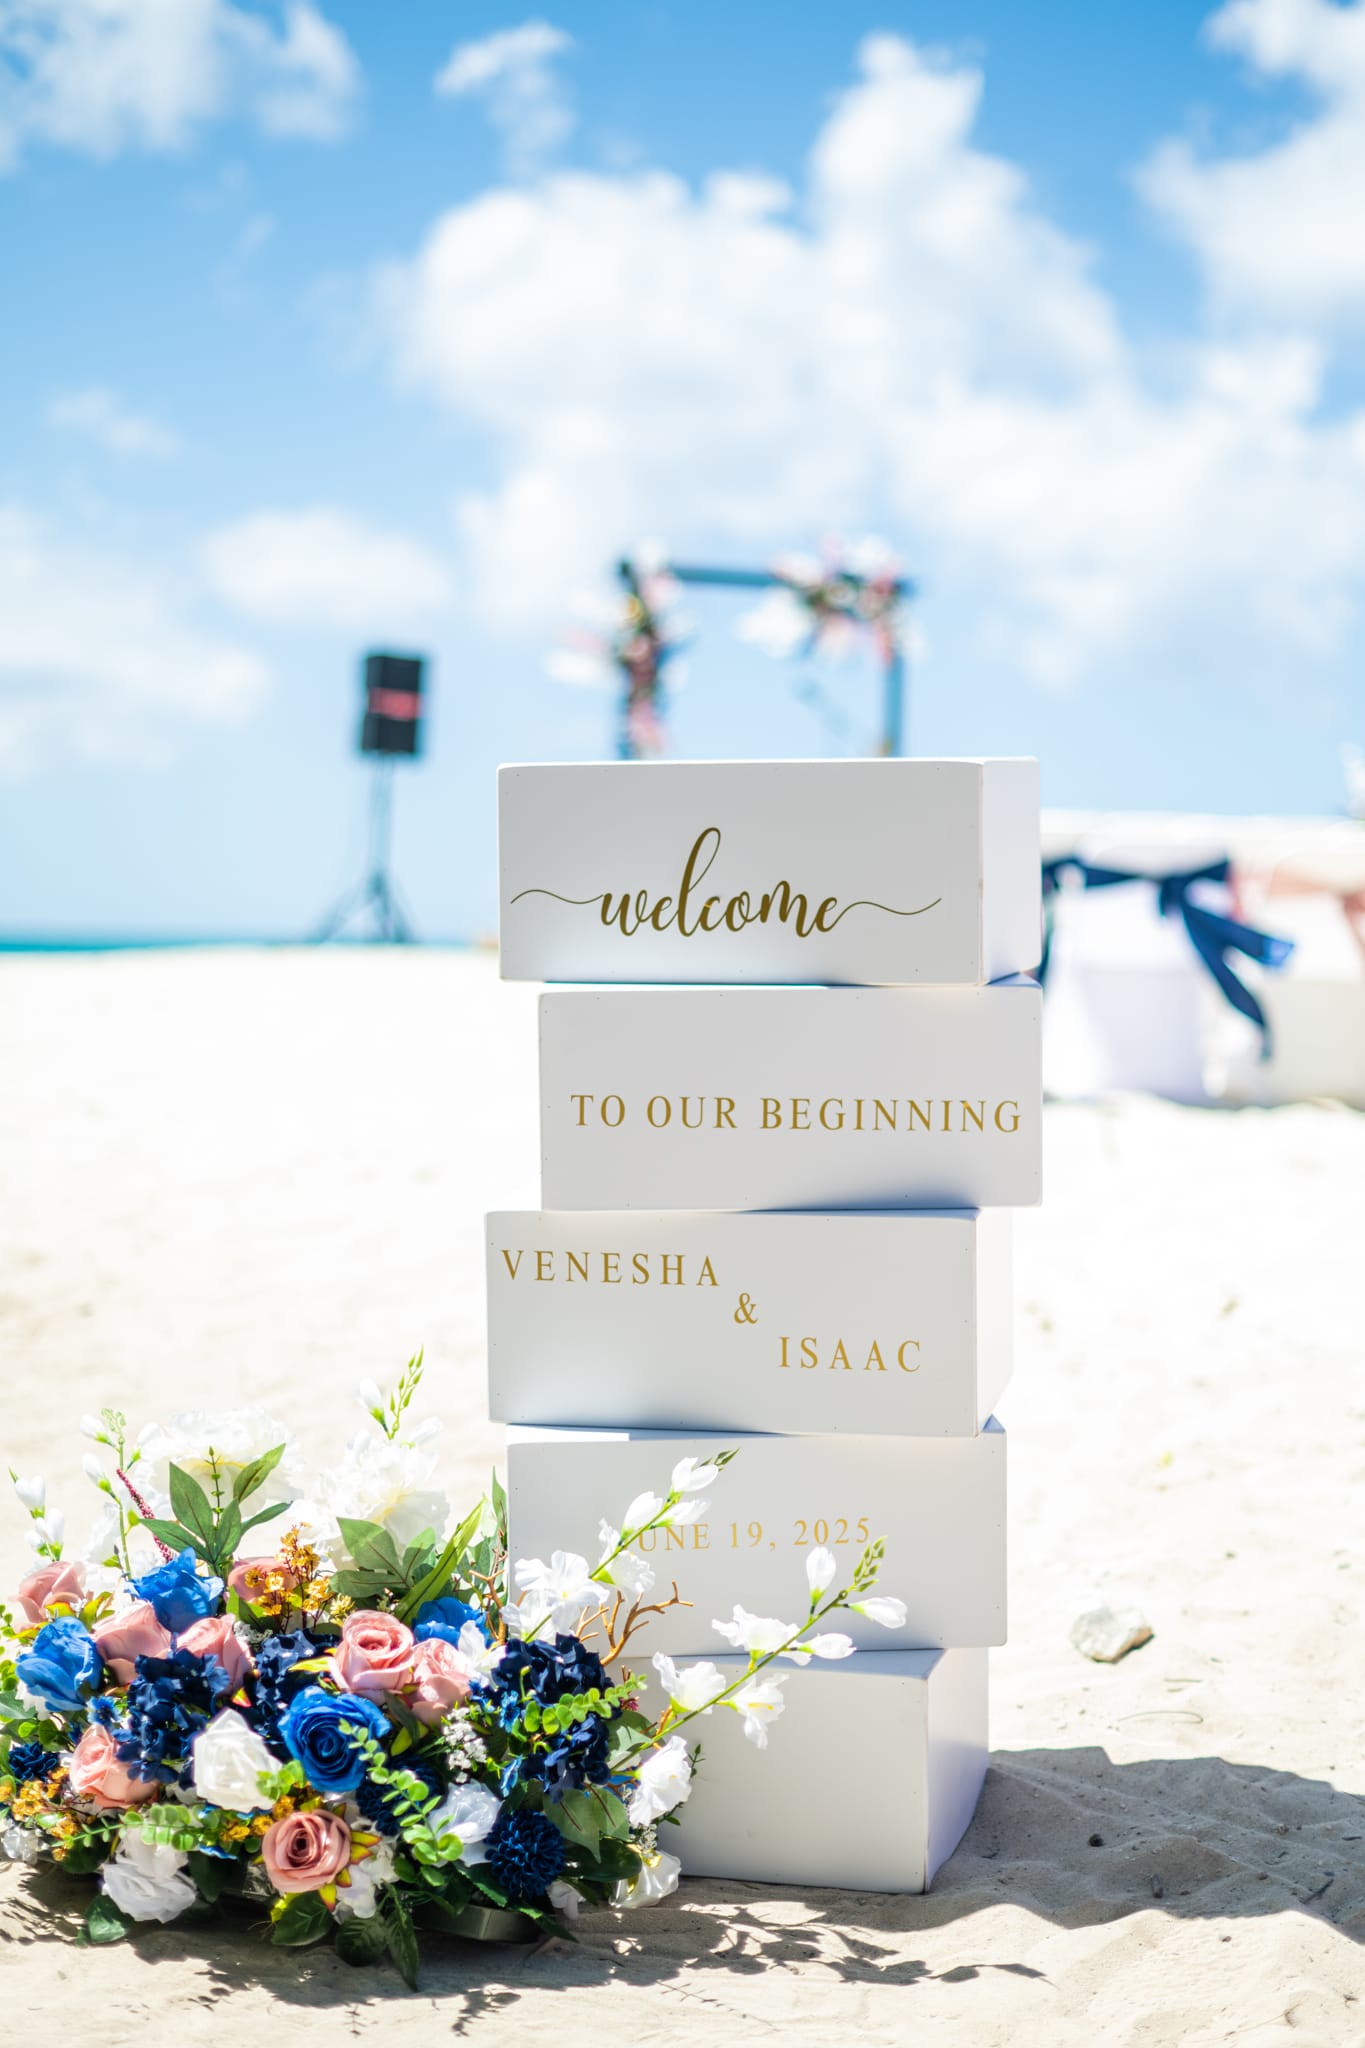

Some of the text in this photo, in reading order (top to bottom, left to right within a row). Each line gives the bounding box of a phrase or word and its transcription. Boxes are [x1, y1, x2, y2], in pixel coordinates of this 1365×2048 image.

[511, 827, 941, 938] welcome
[570, 1094, 1021, 1133] TO OUR BEGINNING
[501, 1249, 720, 1287] VENESHA
[733, 1292, 758, 1325] &
[779, 1336, 921, 1372] ISAAC
[624, 1517, 870, 1552] UNE 19, 2025
